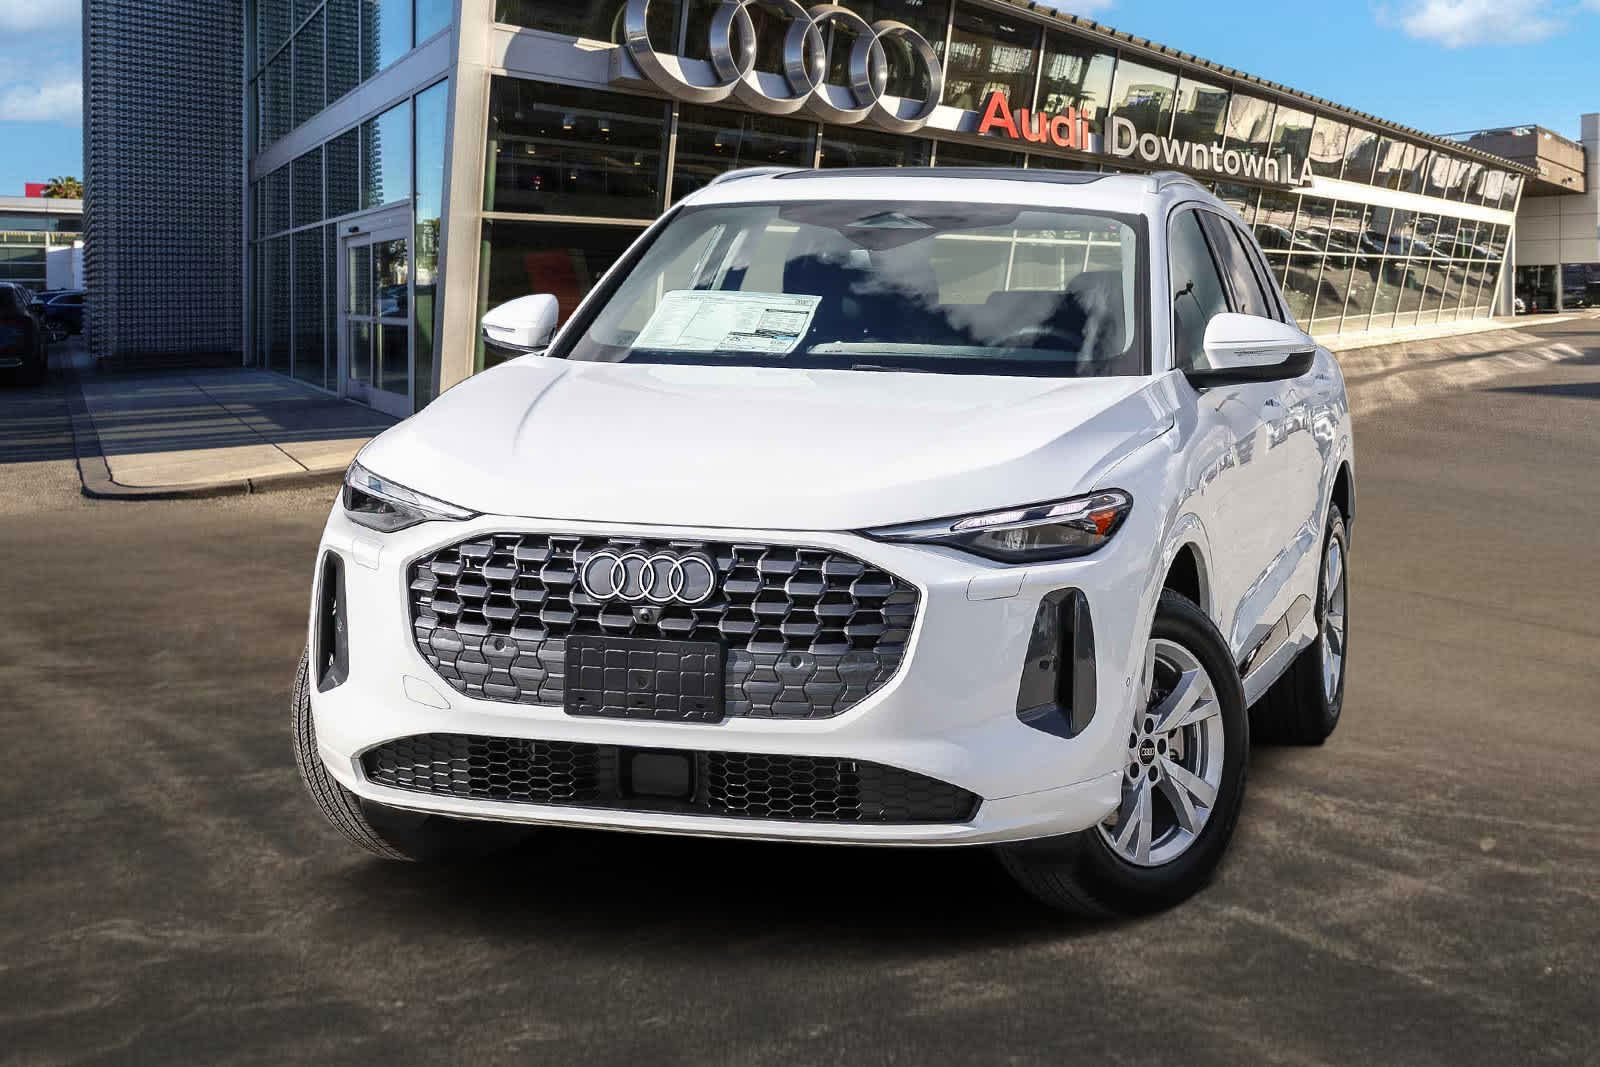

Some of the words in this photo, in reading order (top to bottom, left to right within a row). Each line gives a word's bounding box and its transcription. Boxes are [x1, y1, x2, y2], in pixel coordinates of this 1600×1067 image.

[978, 91, 1089, 150] Audi
[1110, 115, 1279, 183] Downtown
[1287, 153, 1314, 187] LA
